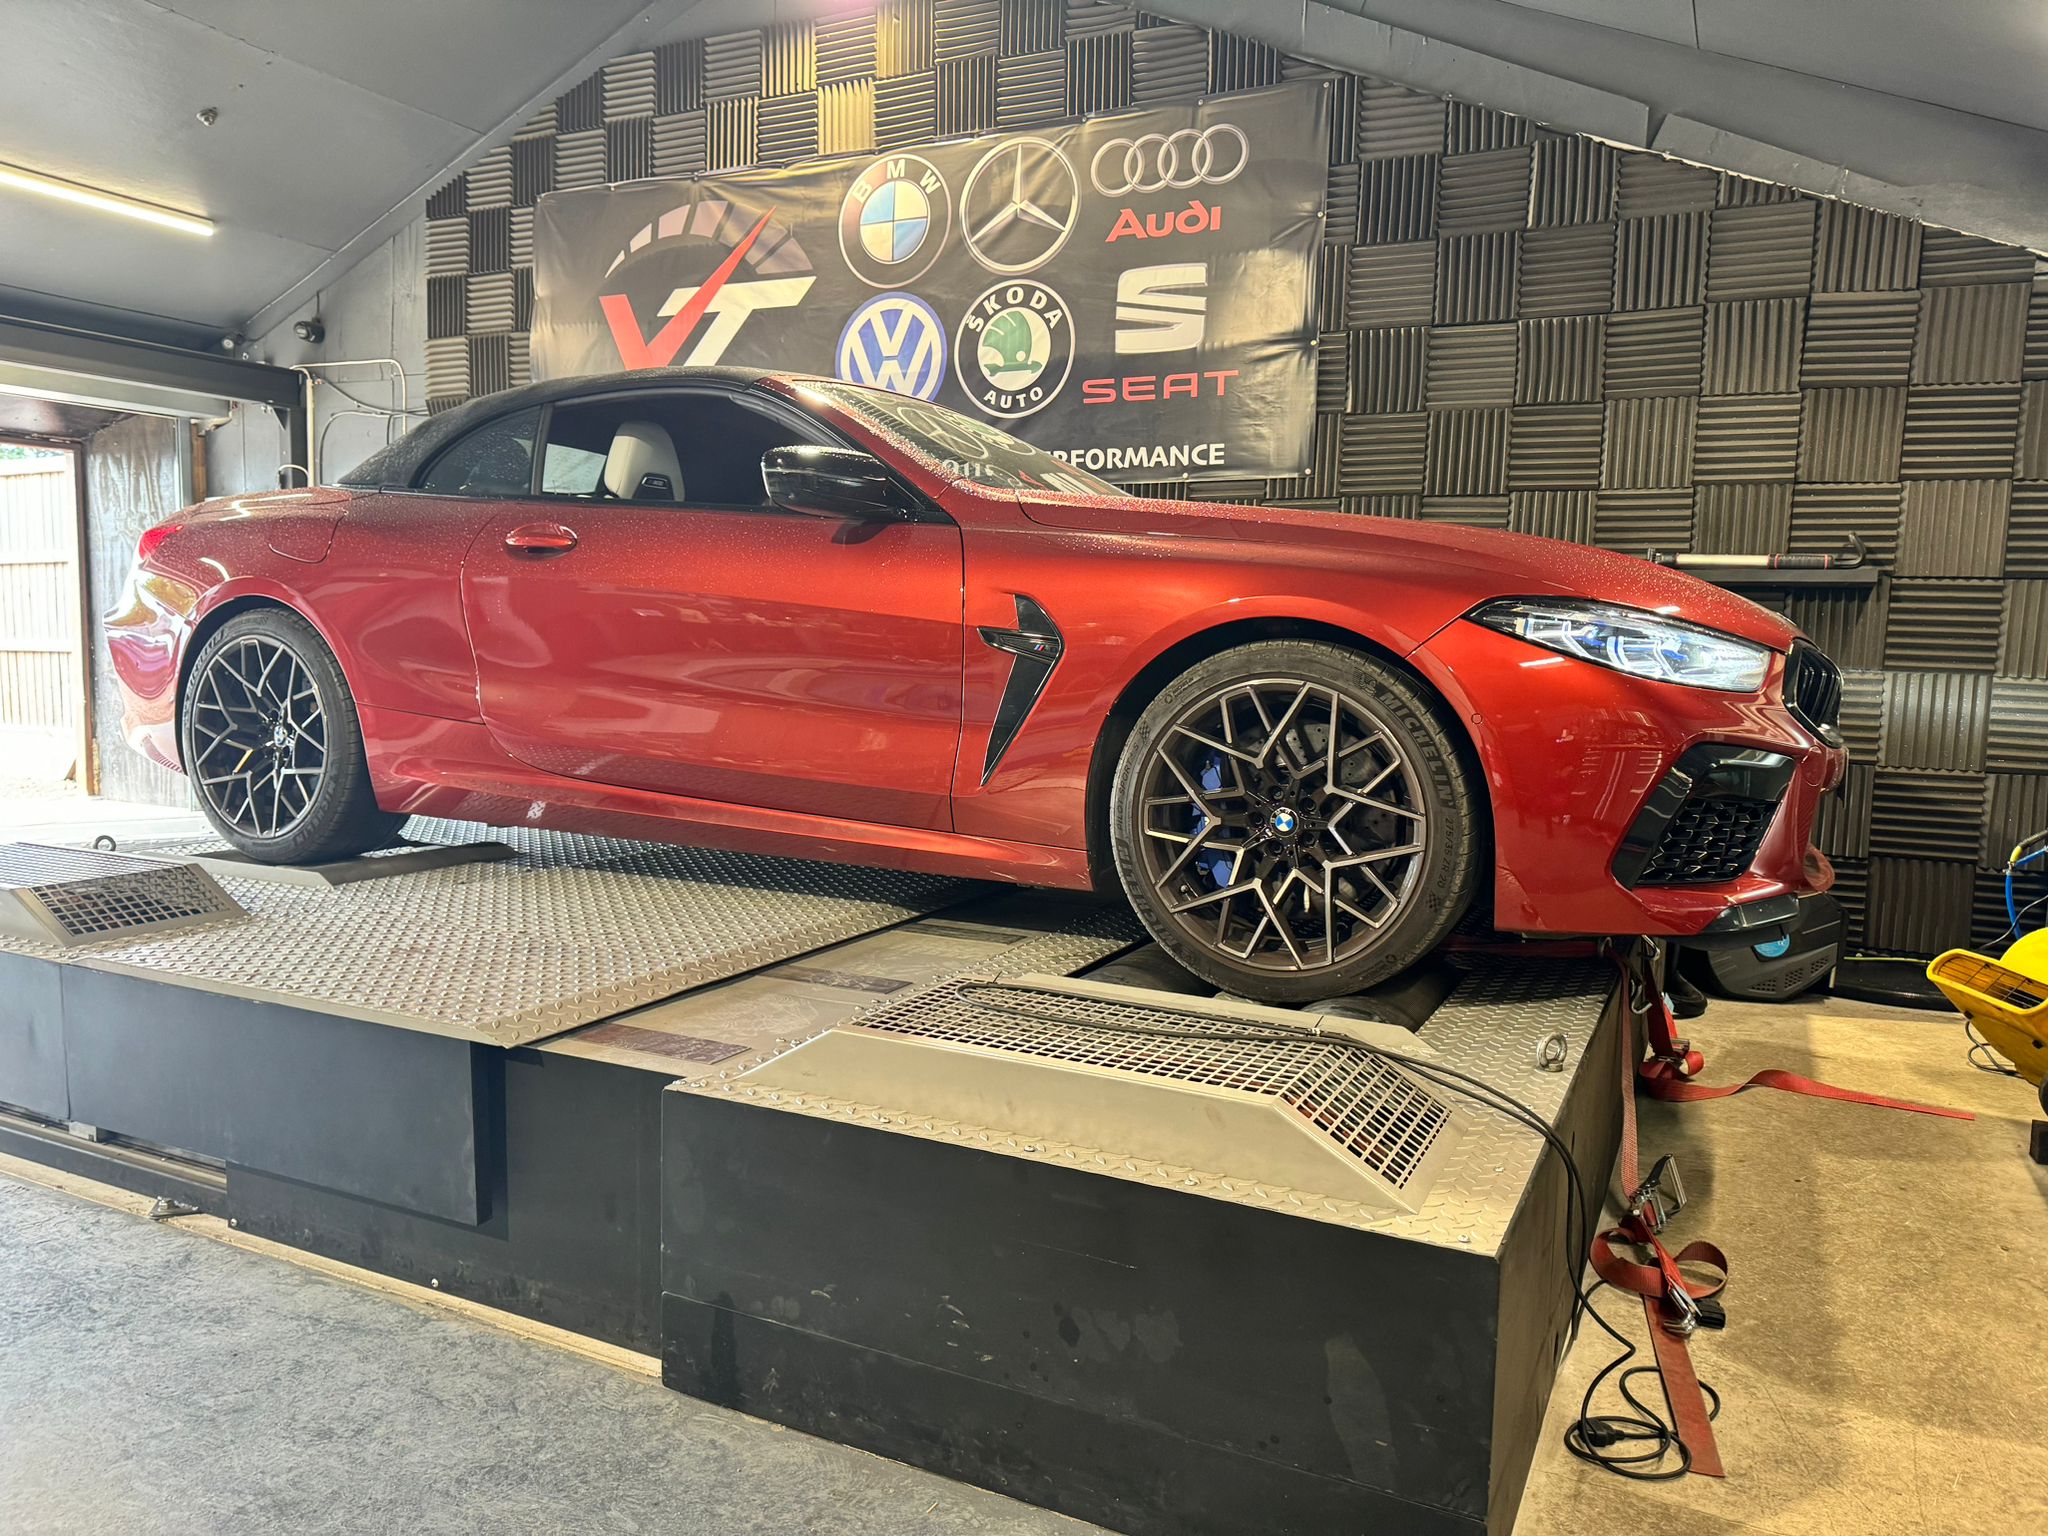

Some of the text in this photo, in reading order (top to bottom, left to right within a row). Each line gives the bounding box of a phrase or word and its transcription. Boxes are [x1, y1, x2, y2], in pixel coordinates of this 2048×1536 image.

[852, 158, 942, 204] BMW
[1105, 199, 1222, 242] Audi
[983, 386, 1044, 409] AUTO
[1082, 369, 1240, 404] SEAT
[1379, 691, 1453, 798] MICHELIN
